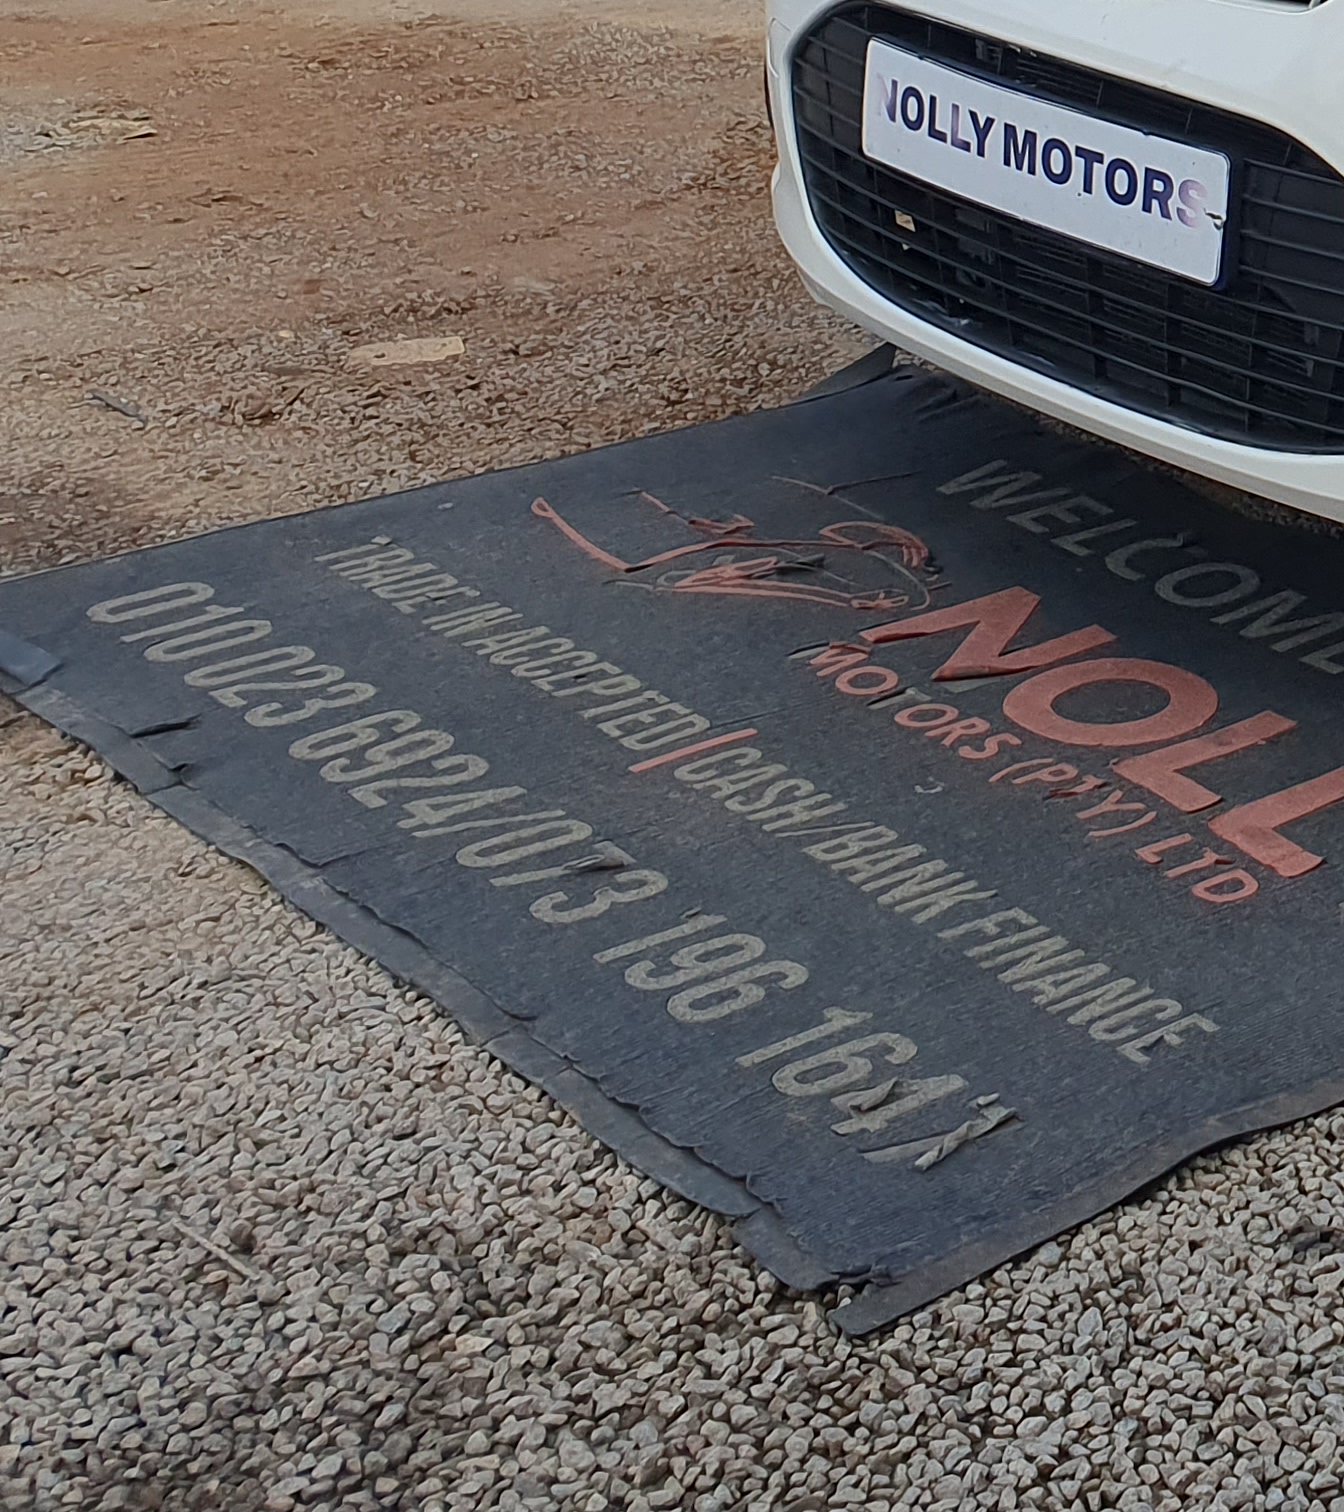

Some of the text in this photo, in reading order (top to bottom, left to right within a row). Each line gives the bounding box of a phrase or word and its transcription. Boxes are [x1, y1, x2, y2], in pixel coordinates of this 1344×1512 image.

[1003, 122, 1210, 229] MOTORS
[314, 536, 481, 614] TRADE
[421, 601, 524, 638] IN
[936, 907, 1221, 1065] FINANCE
[988, 757, 1158, 839] (PTY)
[1135, 833, 1259, 903] LTD
[593, 908, 809, 1023] 196
